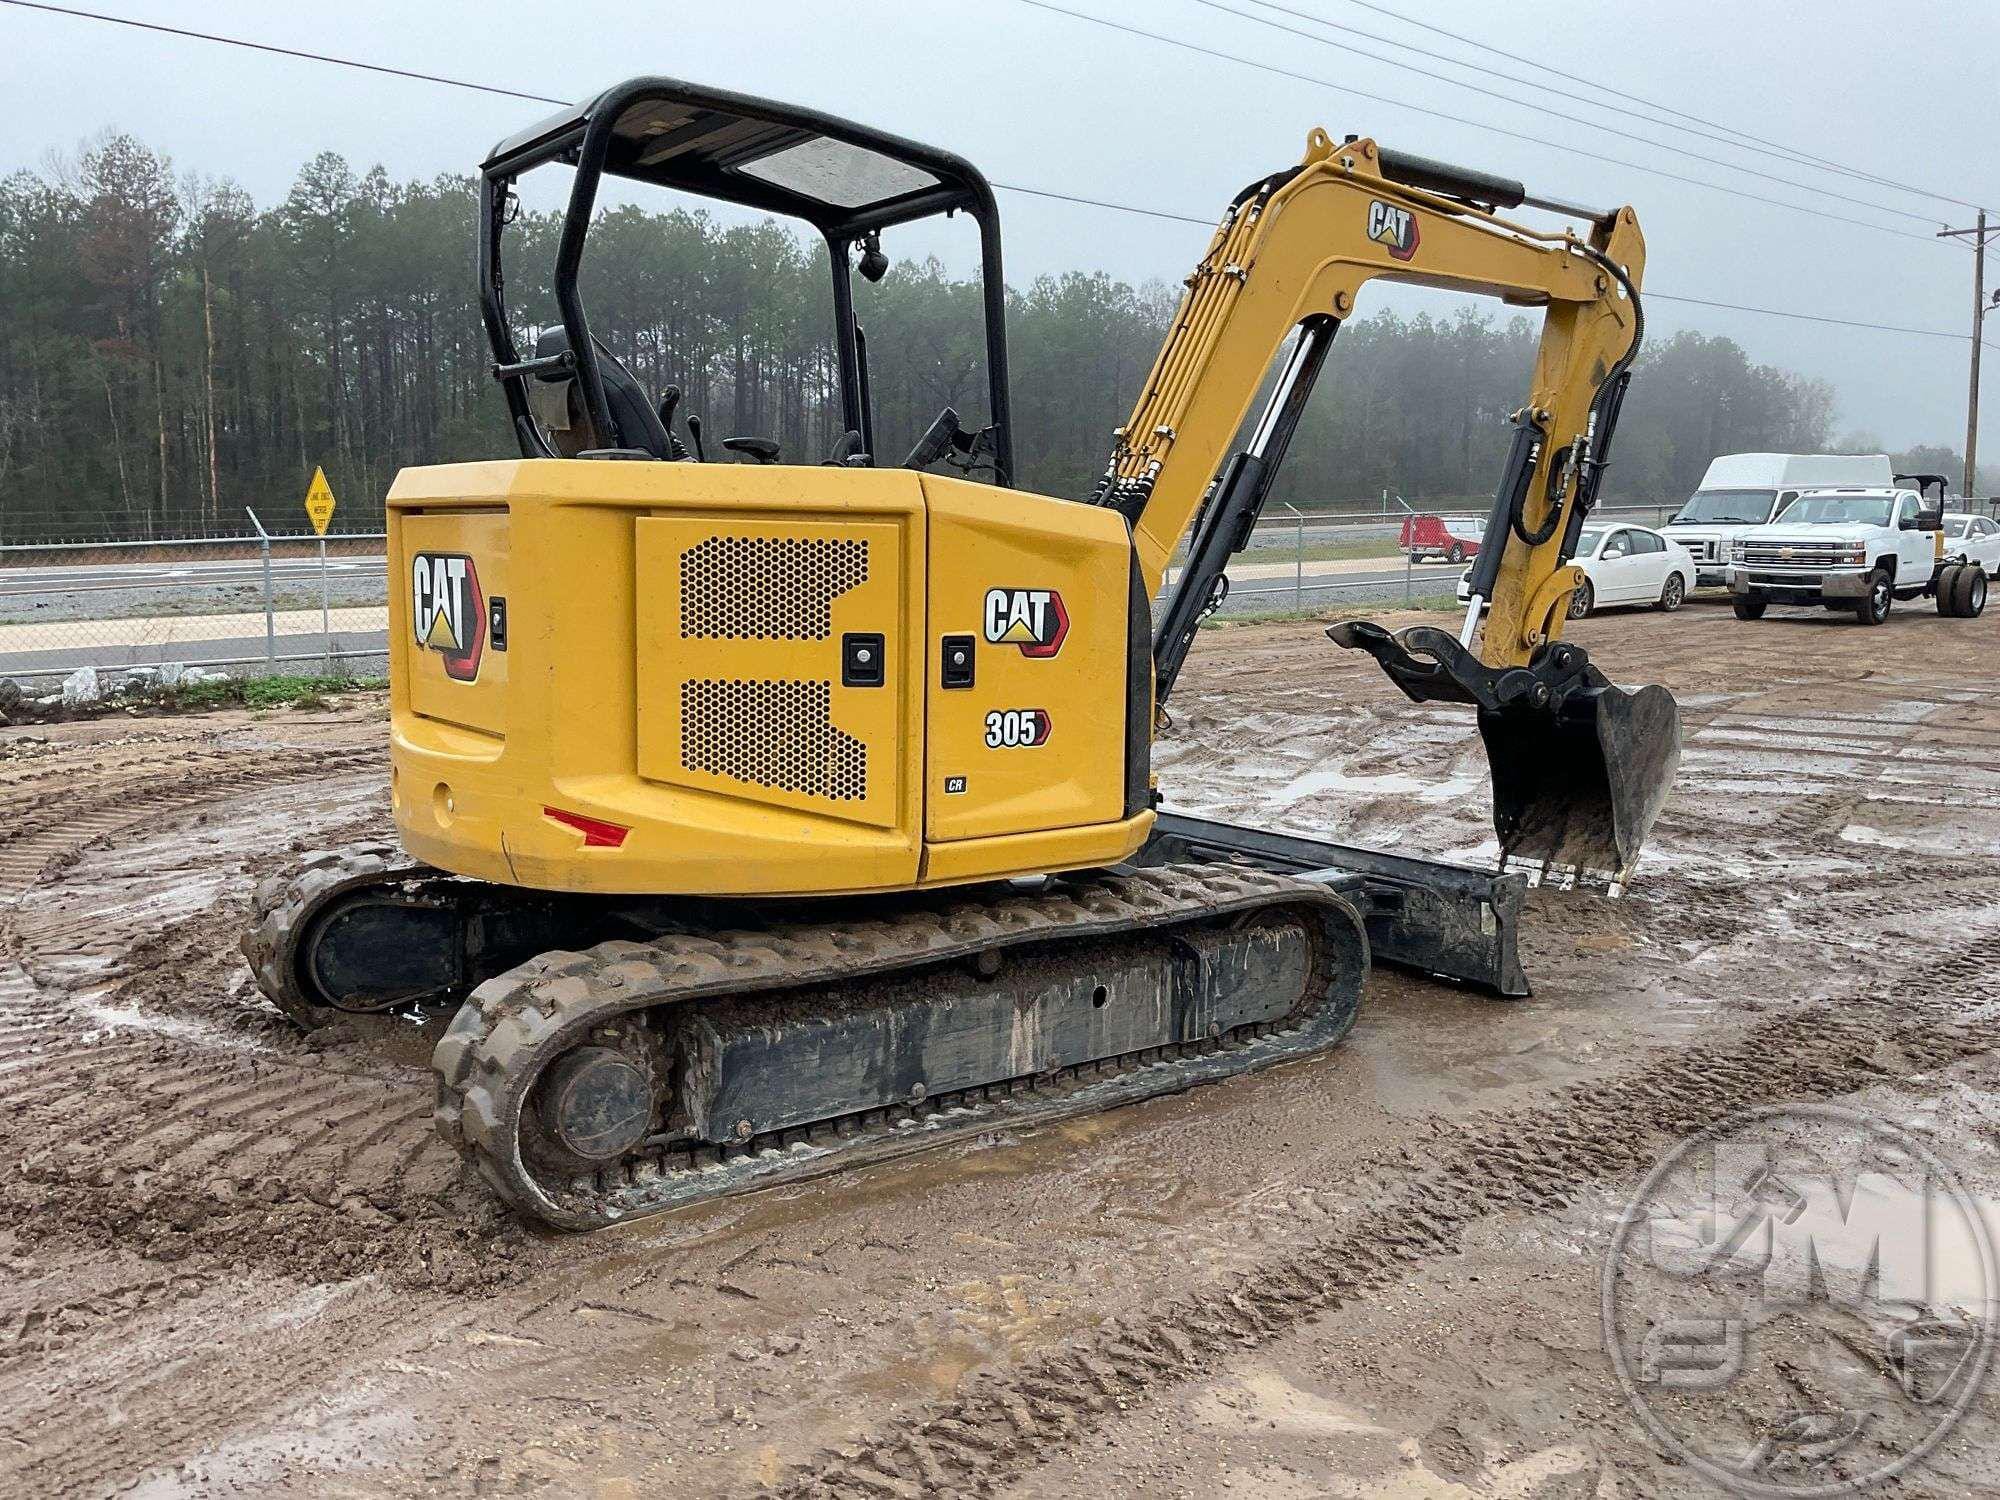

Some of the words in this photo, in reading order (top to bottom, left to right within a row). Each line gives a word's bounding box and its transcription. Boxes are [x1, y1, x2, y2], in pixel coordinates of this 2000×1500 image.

[1368, 201, 1410, 249] CAT
[413, 555, 467, 650] CAT
[985, 588, 1051, 643] CAT
[985, 710, 1036, 747] 305
[947, 778, 964, 792] CR
